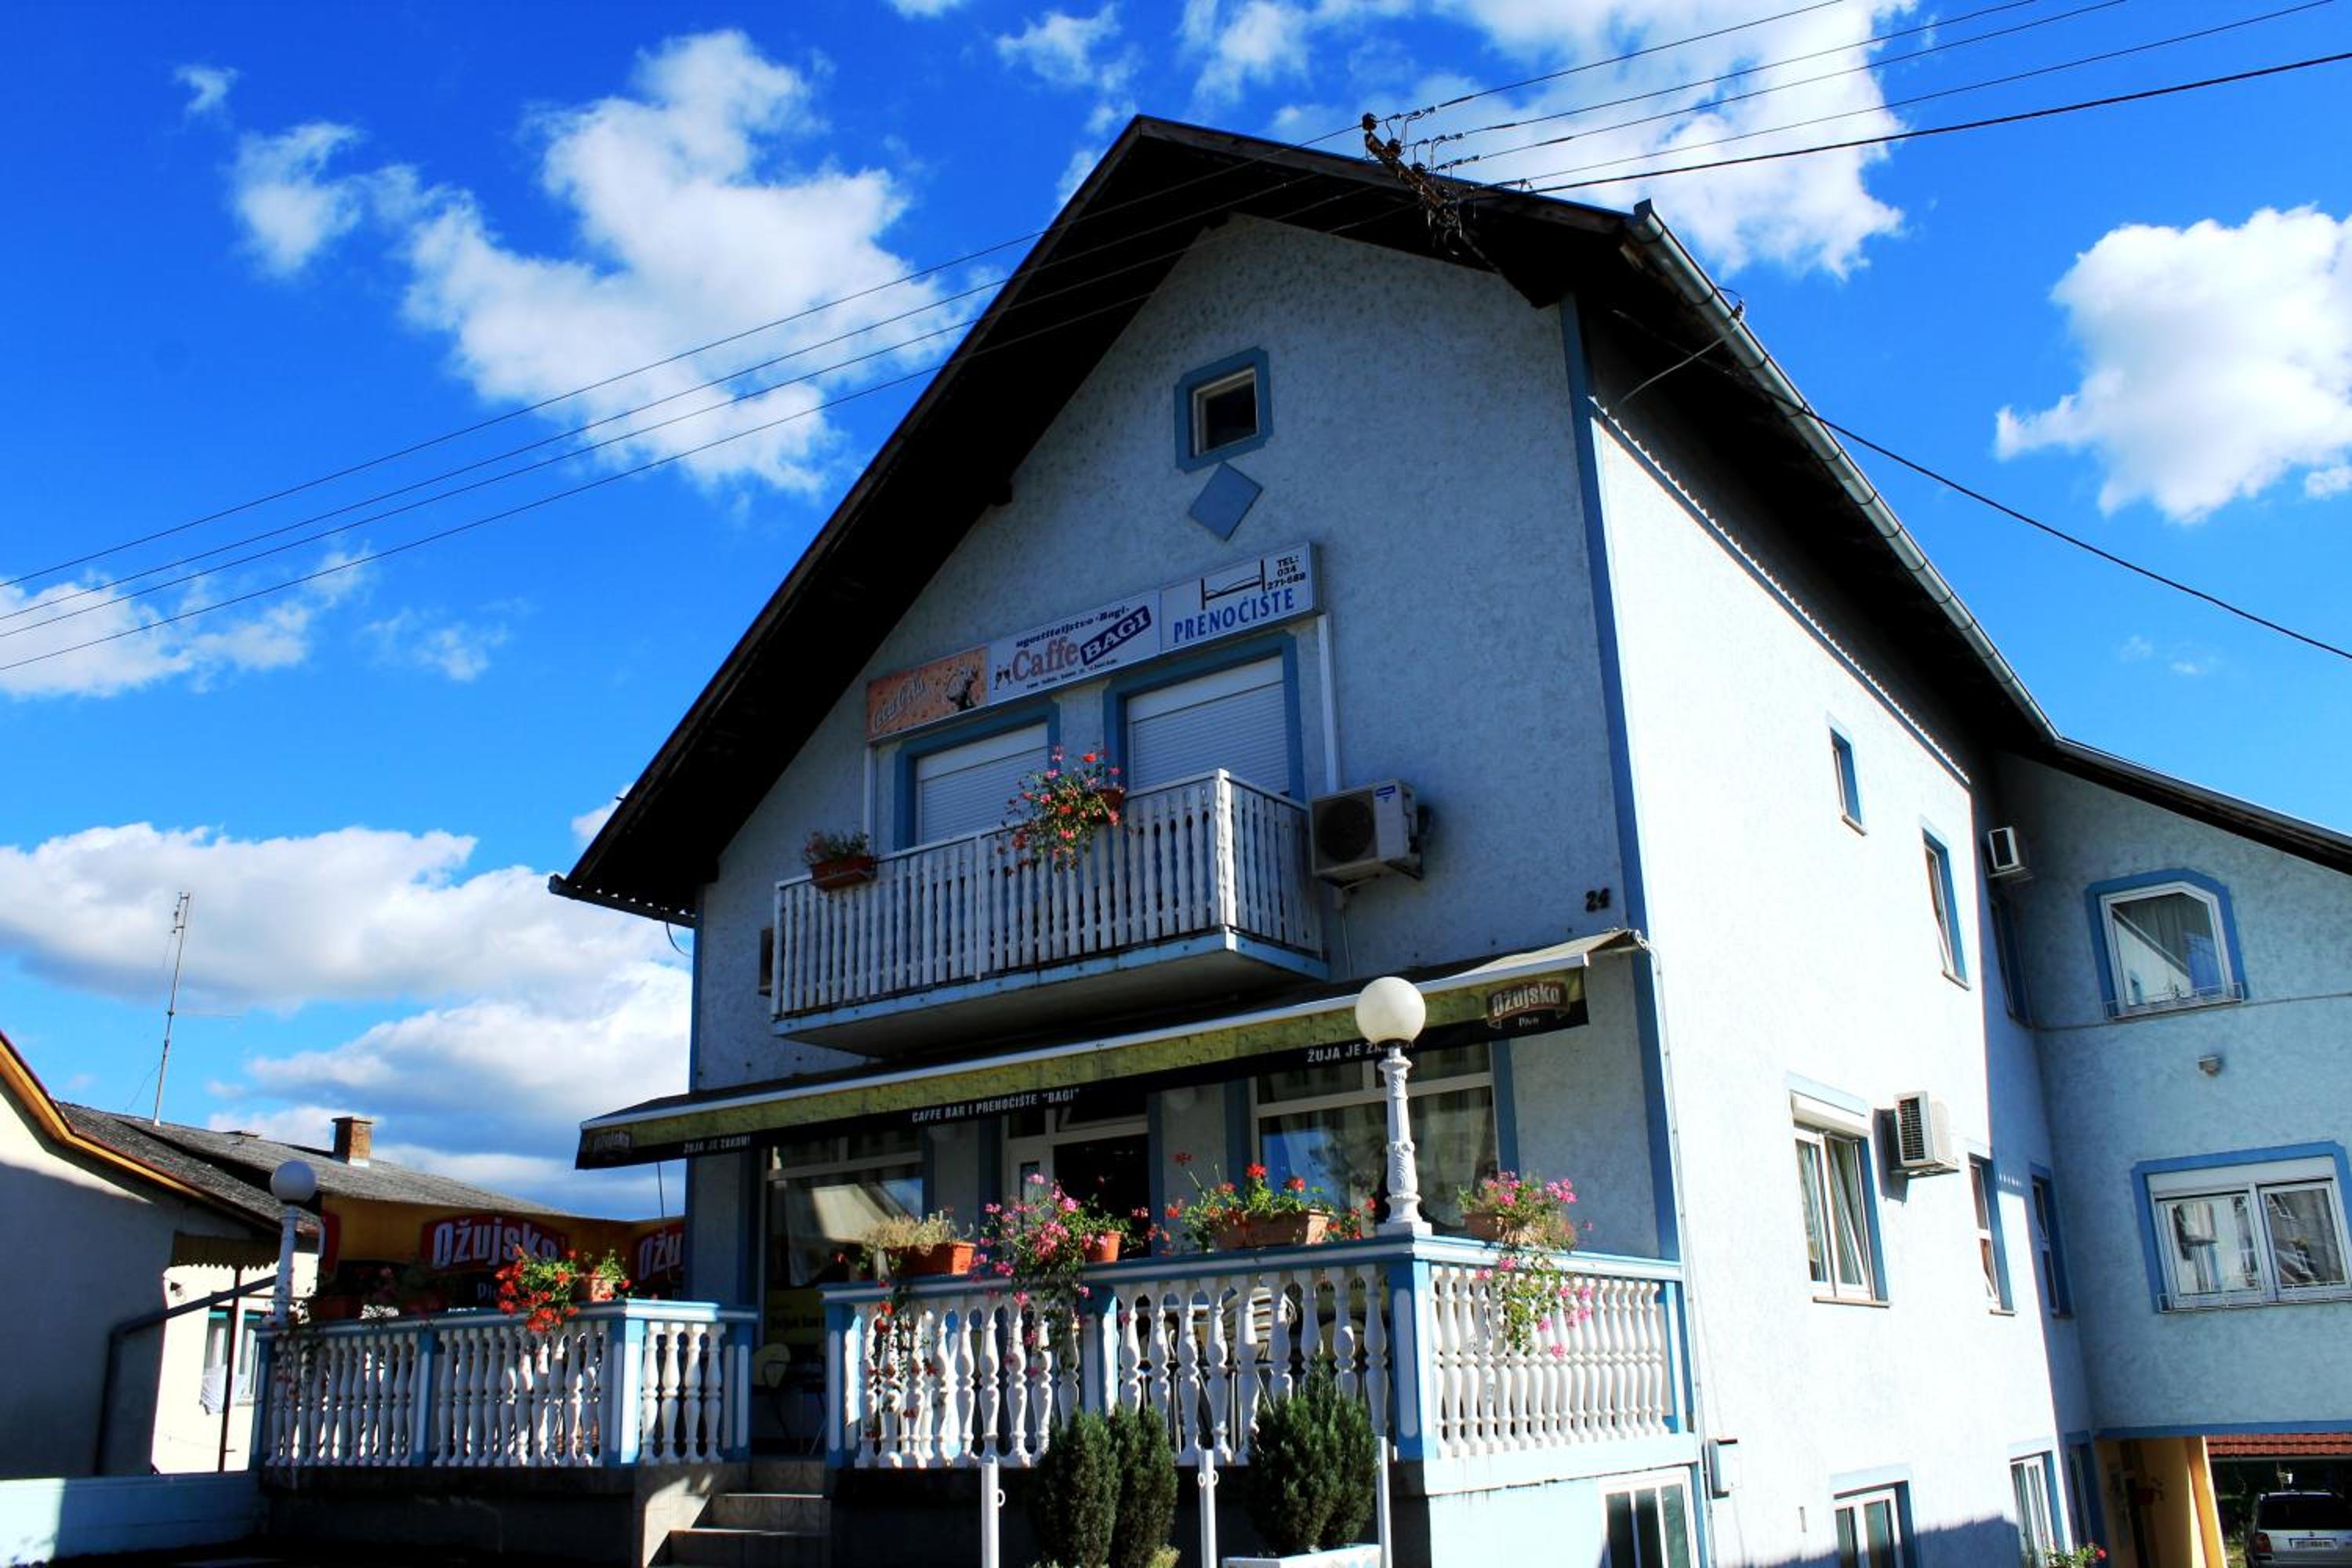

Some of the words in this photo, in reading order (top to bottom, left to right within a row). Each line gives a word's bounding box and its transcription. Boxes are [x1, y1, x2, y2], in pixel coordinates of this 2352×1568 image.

[1277, 565, 1297, 577] 034
[1083, 610, 1149, 662] BAGI
[1012, 636, 1079, 681] Caffe
[1345, 1044, 1362, 1057] JE
[912, 1108, 942, 1123] CAFFE
